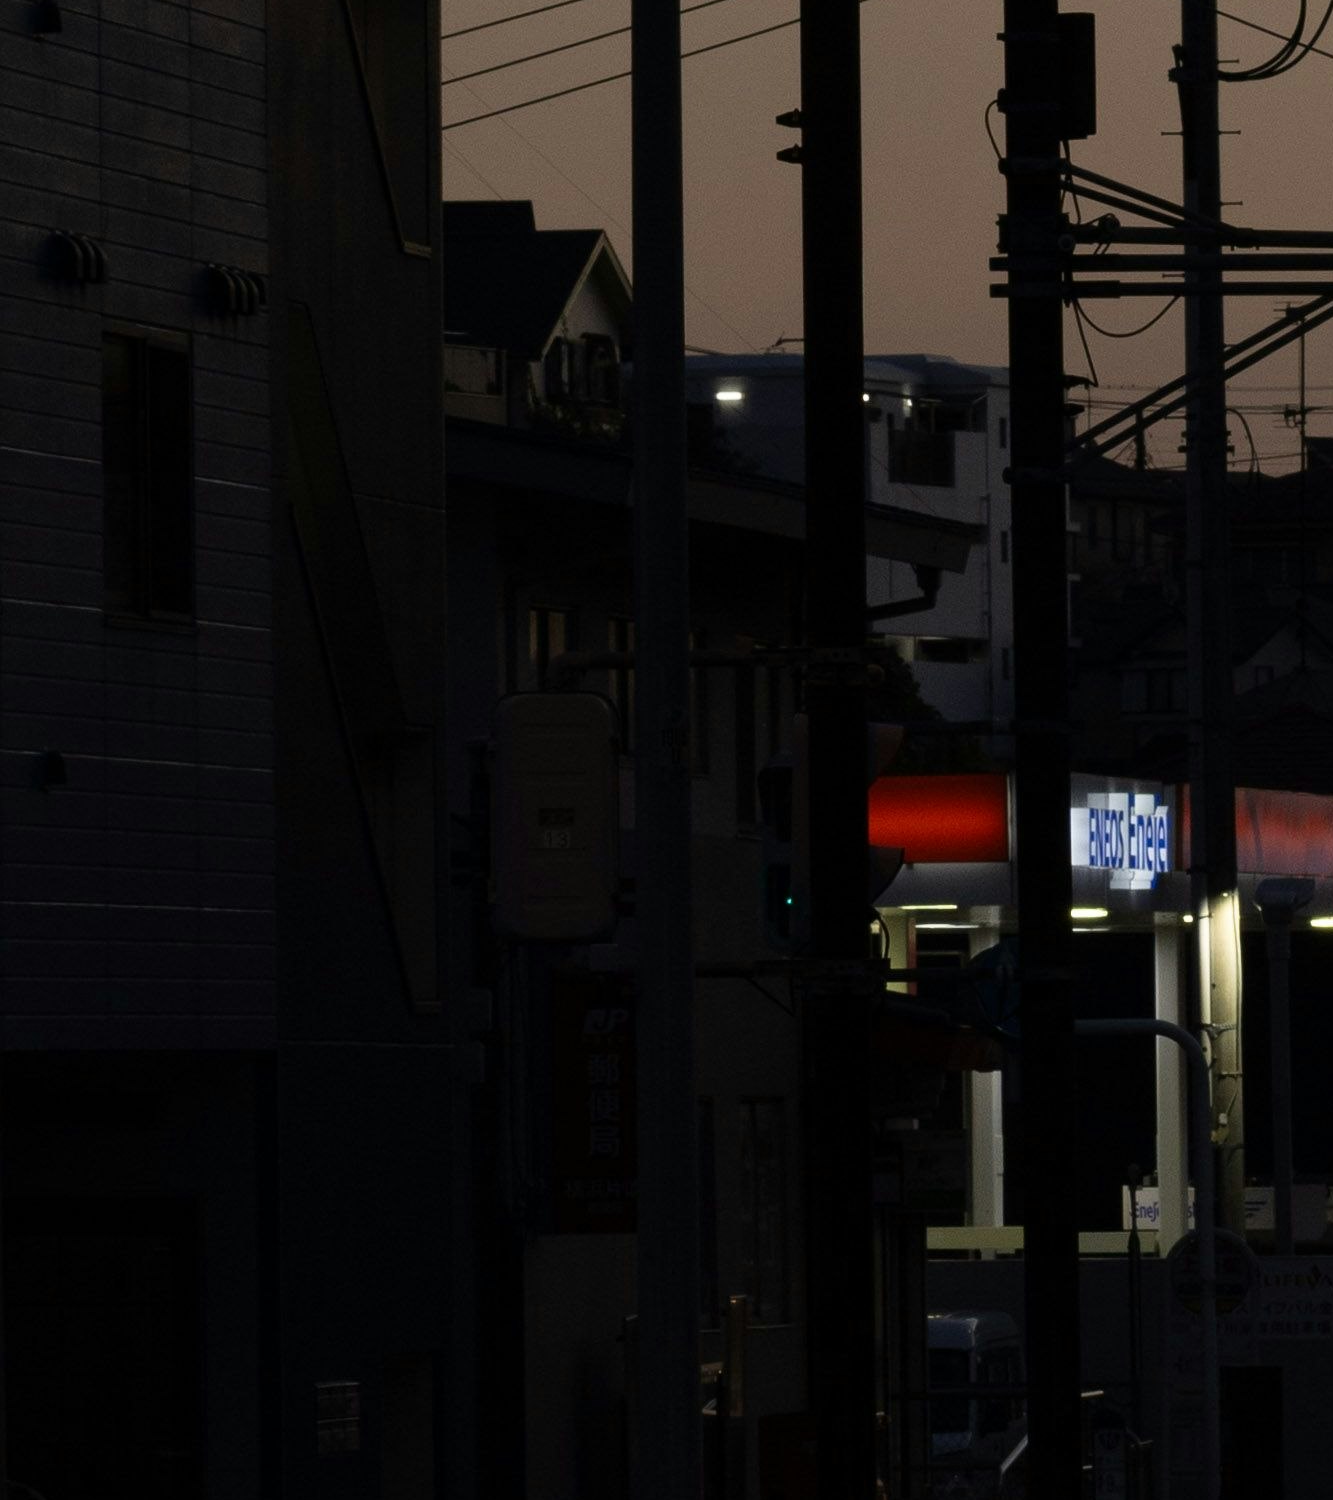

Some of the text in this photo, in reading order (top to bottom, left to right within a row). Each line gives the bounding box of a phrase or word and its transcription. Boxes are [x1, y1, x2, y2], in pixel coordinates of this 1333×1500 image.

[1089, 808, 1124, 869] ENEOS
[587, 1053, 620, 1158] 郵便局
